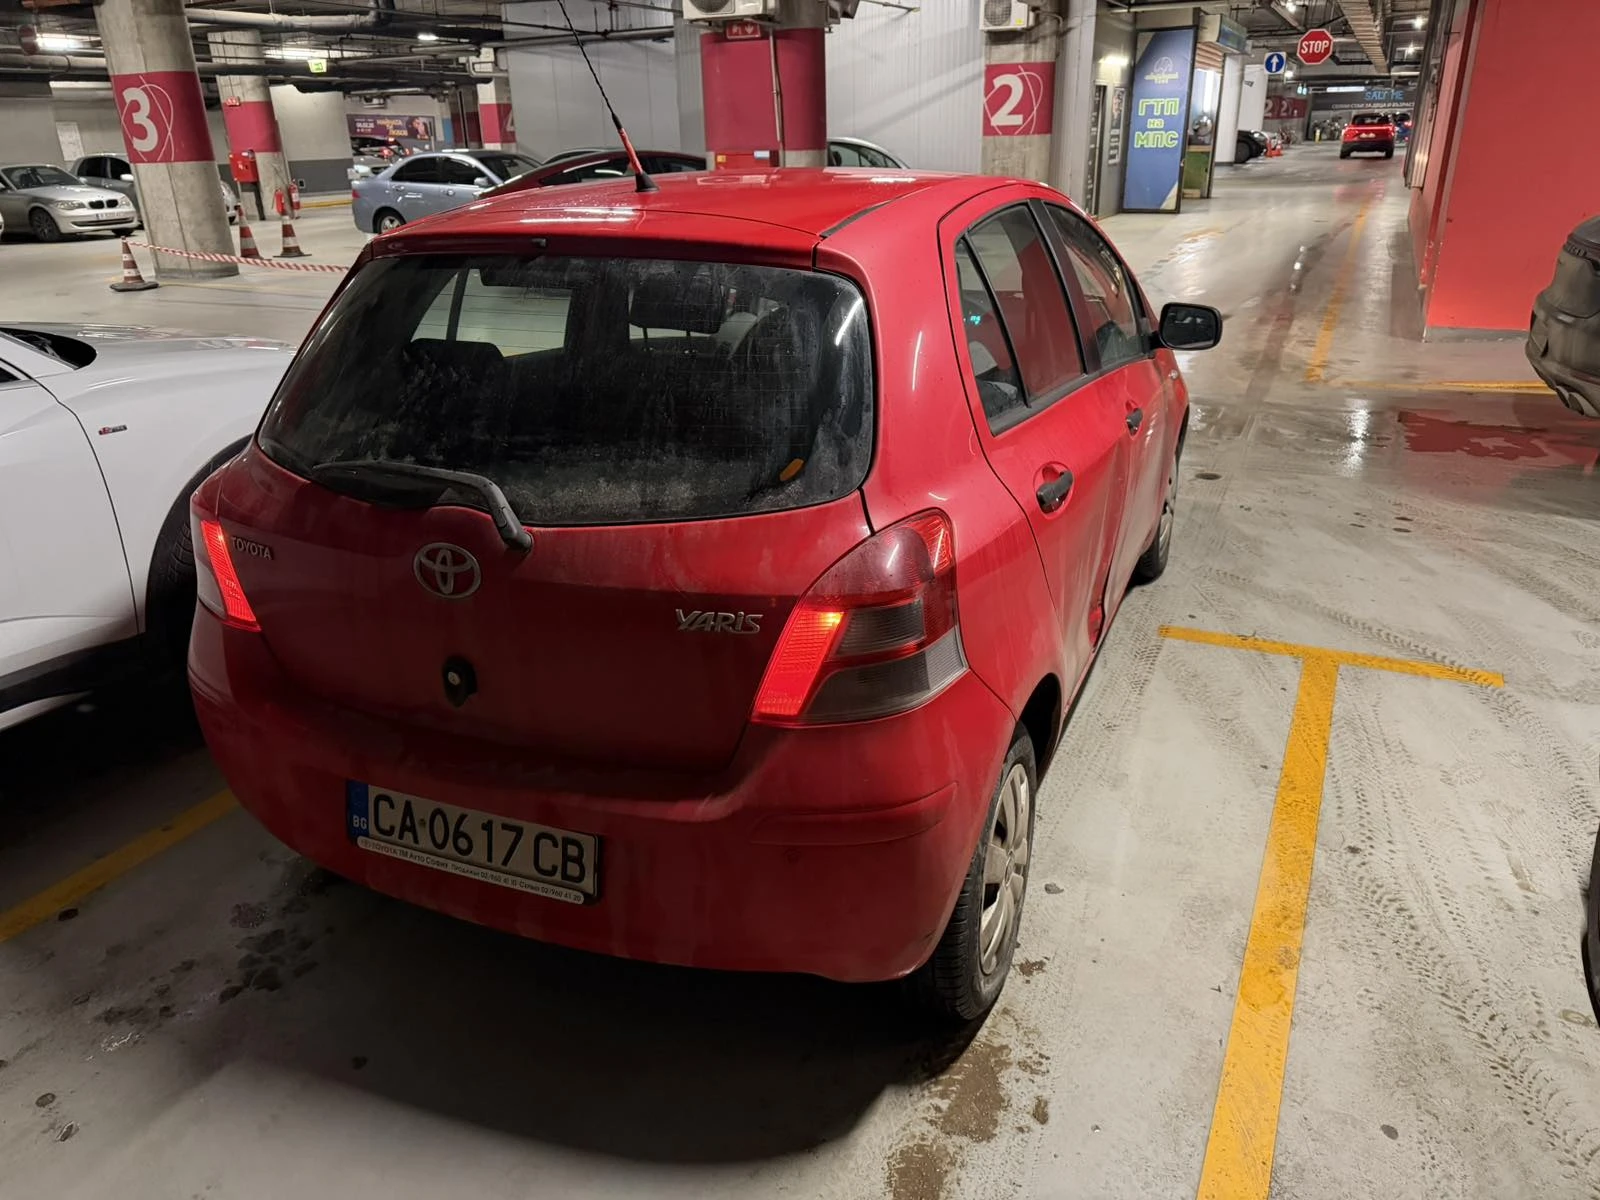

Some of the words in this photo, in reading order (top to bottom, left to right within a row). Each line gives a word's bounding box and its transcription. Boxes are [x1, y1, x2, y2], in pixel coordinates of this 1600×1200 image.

[1301, 40, 1330, 54] STOP
[990, 73, 1024, 127] 2
[1138, 98, 1179, 116] ГТП
[122, 87, 159, 152] 3
[1134, 131, 1178, 148] МПС
[231, 536, 272, 560] TOYOTA
[352, 815, 367, 829] BG
